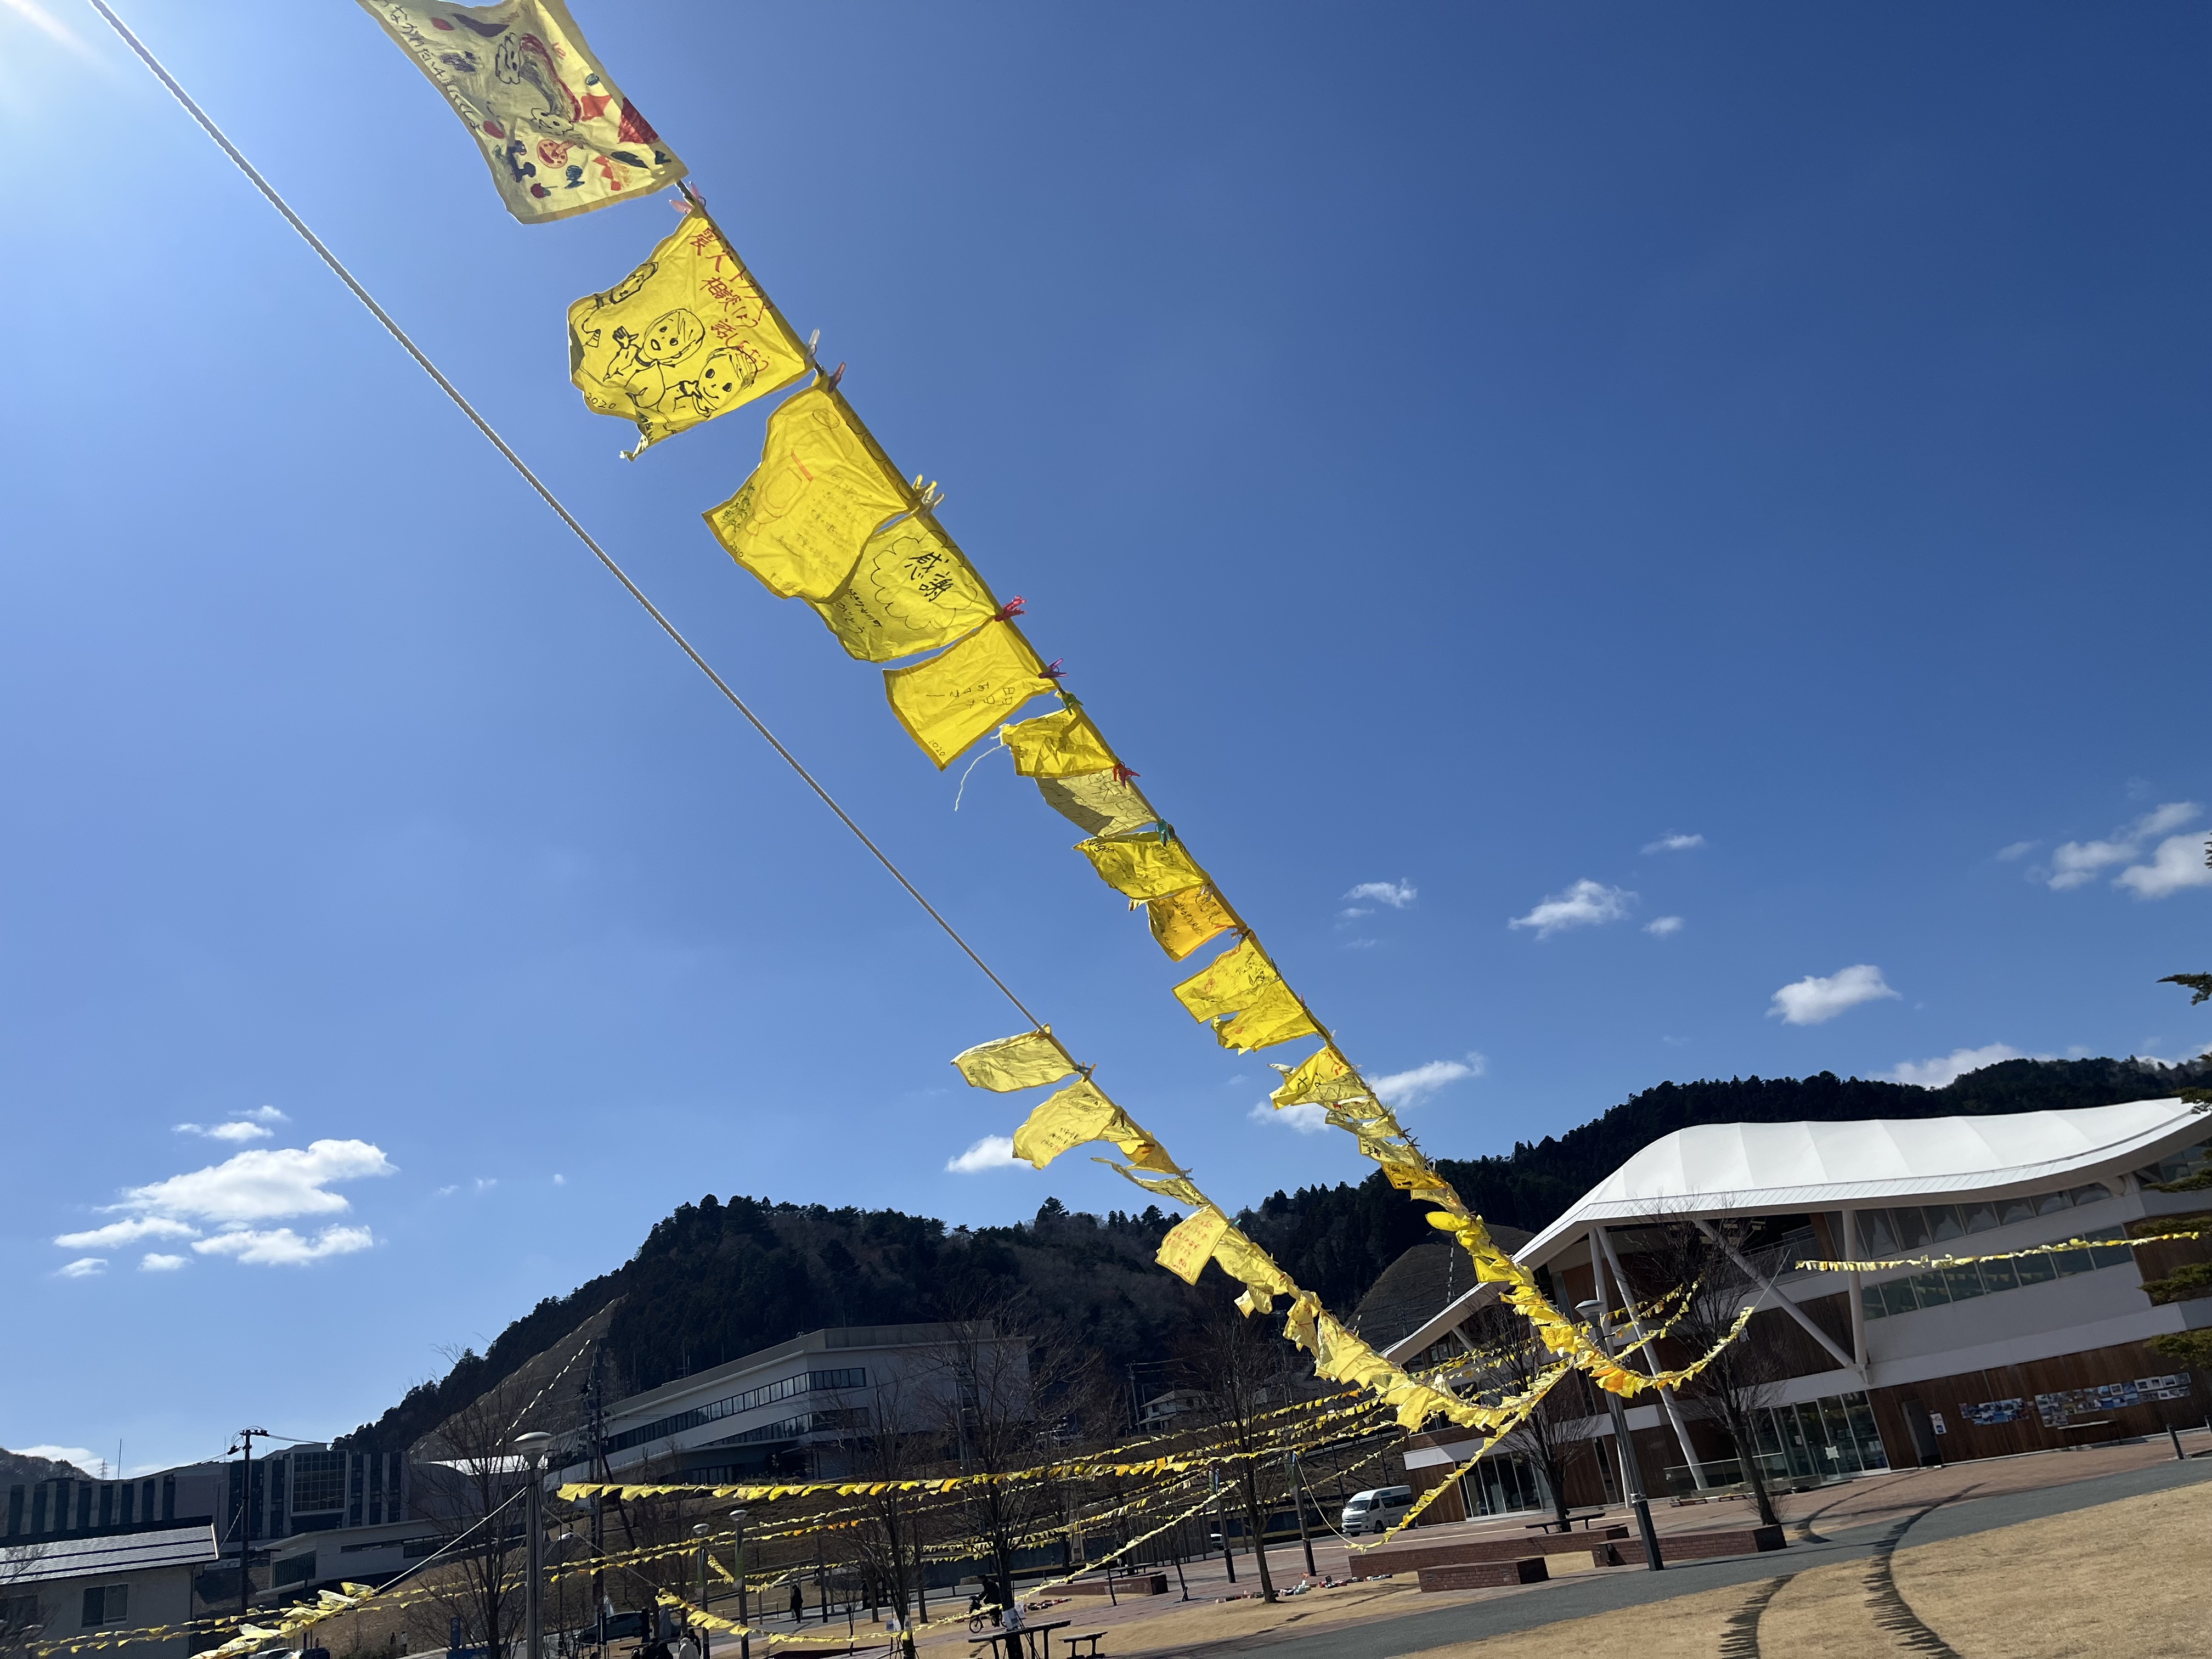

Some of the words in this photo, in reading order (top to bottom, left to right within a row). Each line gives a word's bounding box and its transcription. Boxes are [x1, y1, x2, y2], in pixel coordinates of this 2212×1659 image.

[586, 392, 616, 409] 2020
[904, 551, 953, 602] 感謝
[927, 740, 946, 757] 2020
